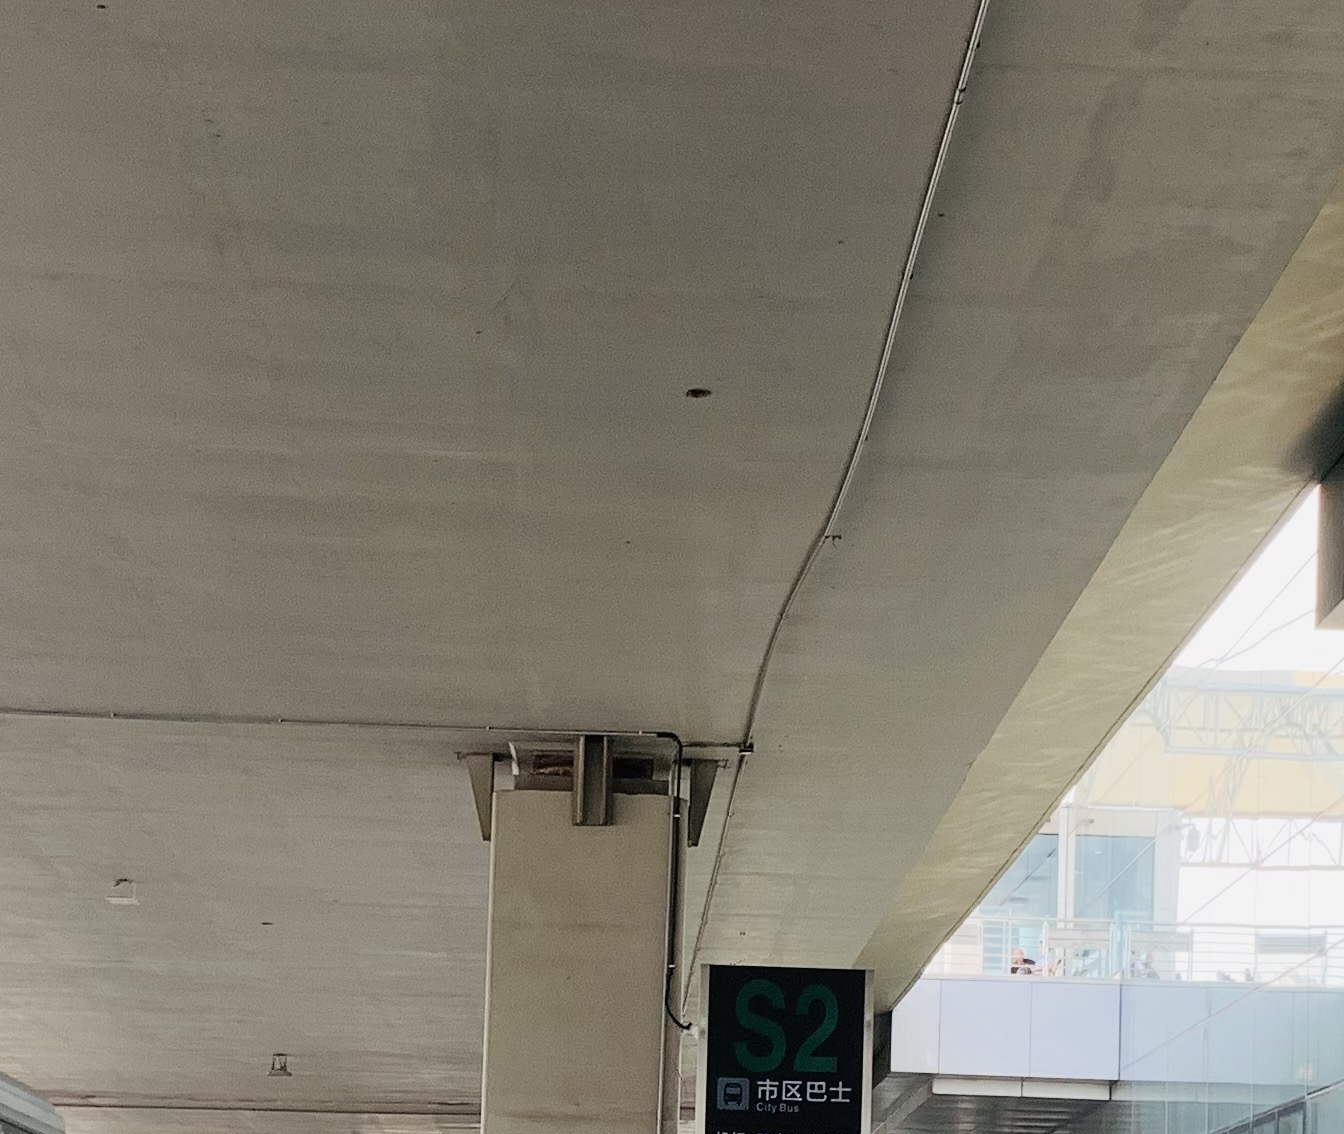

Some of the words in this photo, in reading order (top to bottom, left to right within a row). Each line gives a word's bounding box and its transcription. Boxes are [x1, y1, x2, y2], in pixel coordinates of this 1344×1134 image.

[733, 978, 839, 1073] S2
[756, 1078, 852, 1103] 市区巴士
[756, 1102, 777, 1114] City
[779, 1103, 800, 1113] Bus
